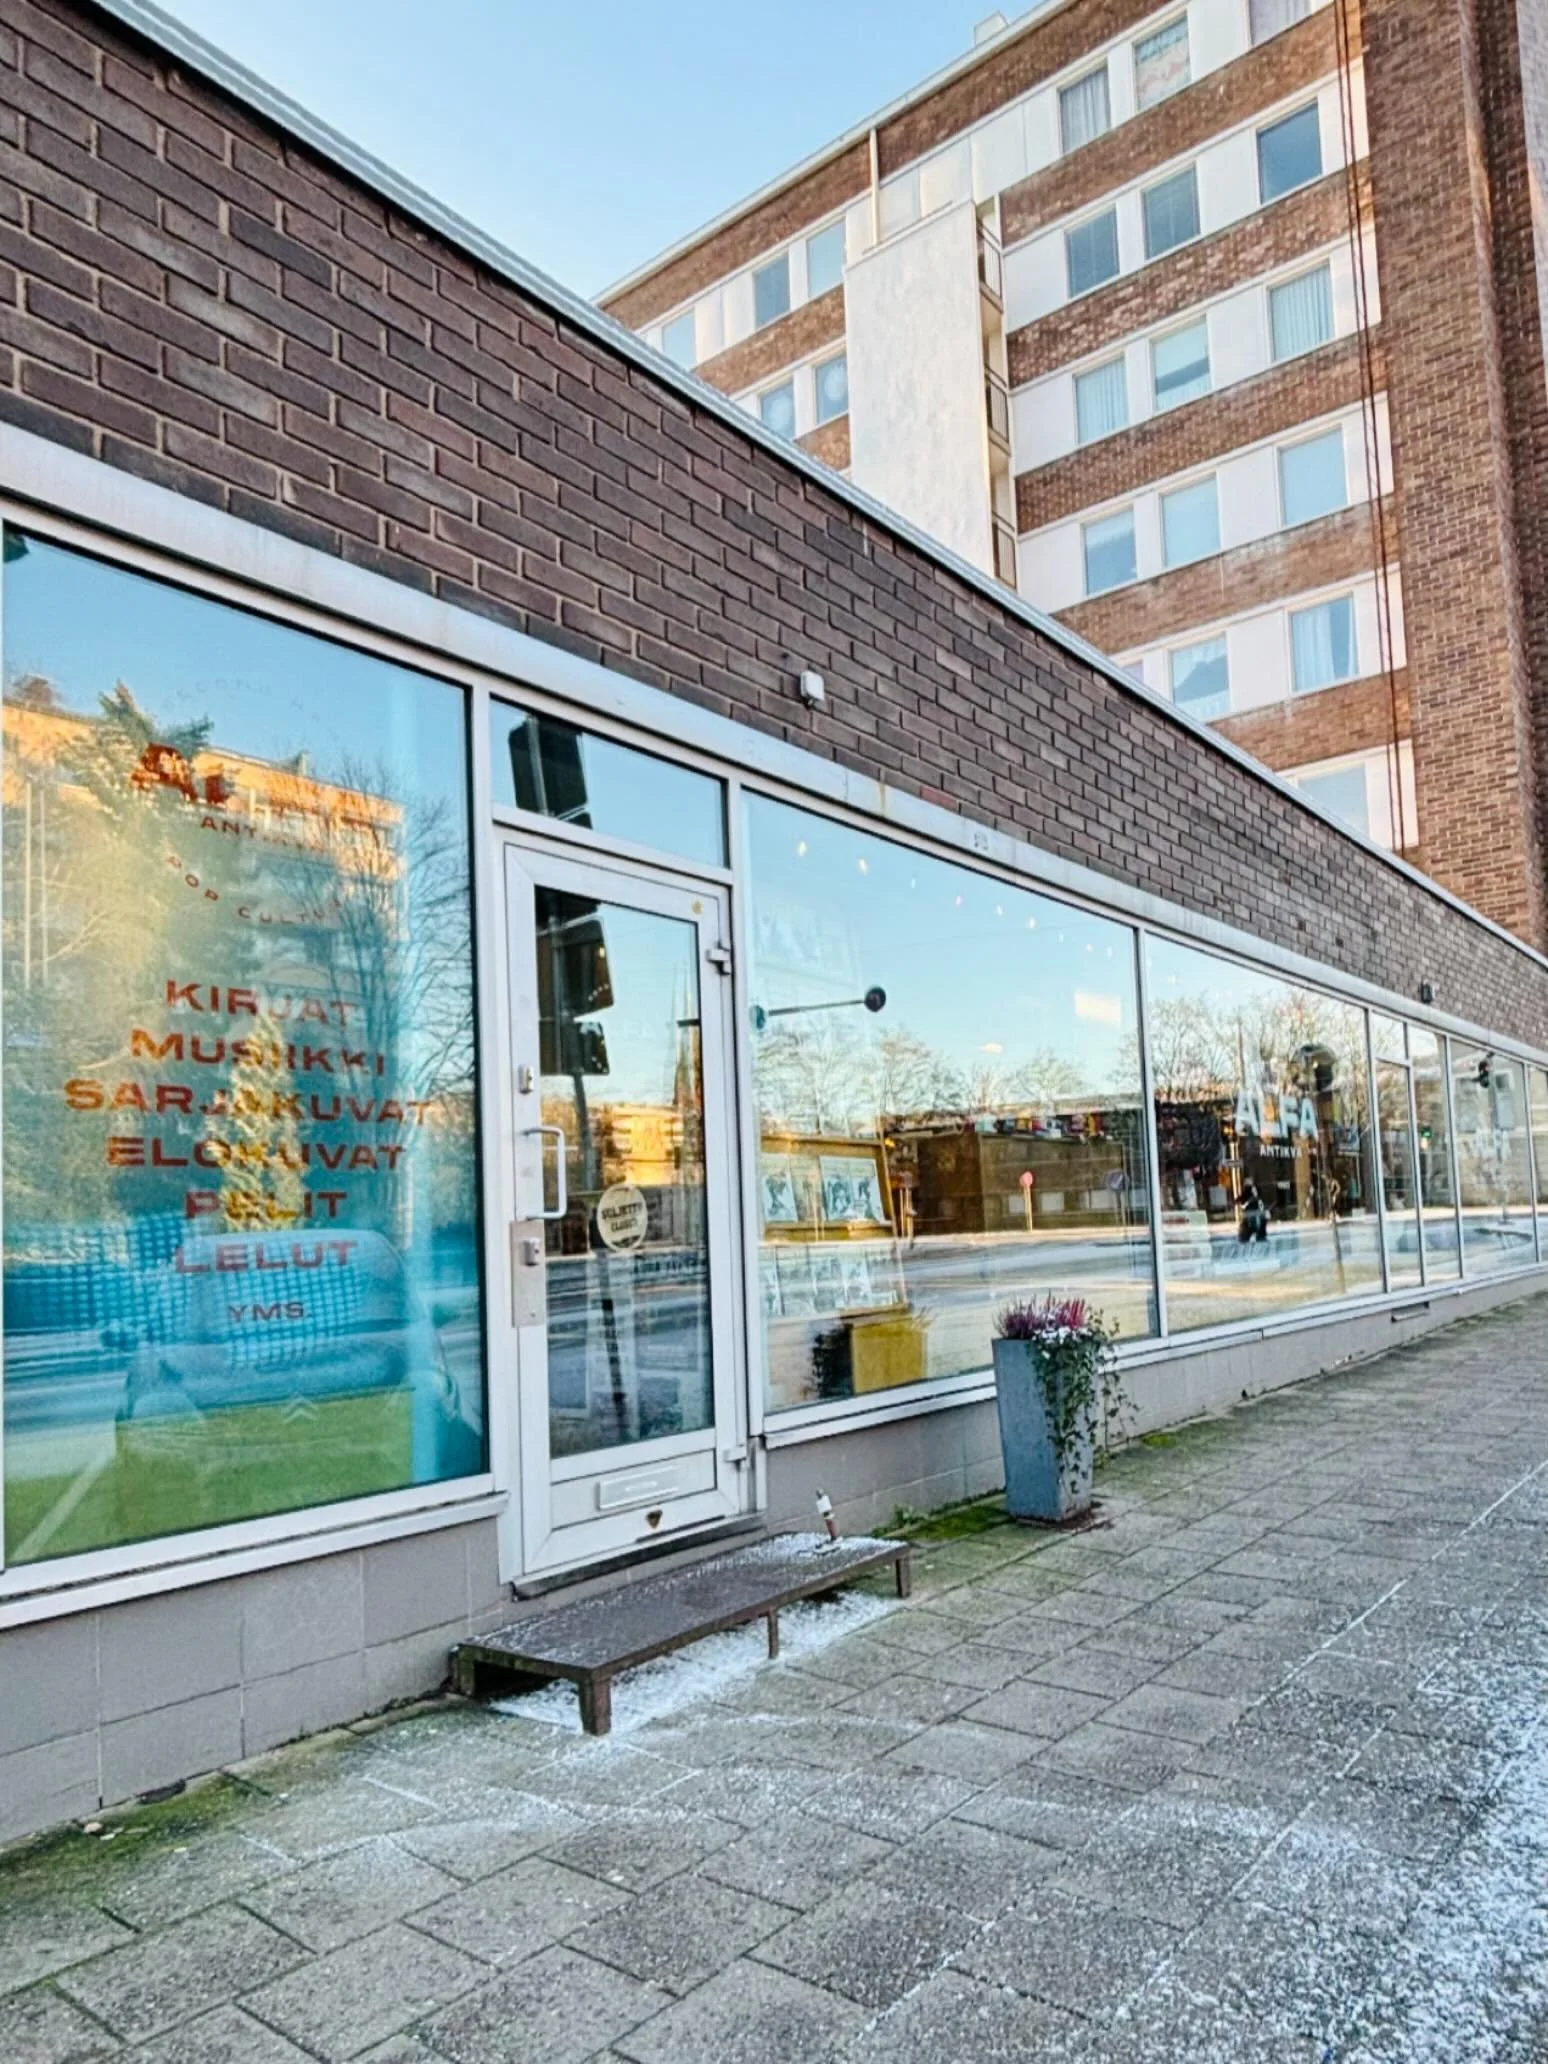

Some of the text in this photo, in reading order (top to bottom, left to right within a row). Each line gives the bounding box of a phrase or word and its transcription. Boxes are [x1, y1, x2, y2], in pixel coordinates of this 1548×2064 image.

[166, 980, 357, 1027] KIRJAT
[131, 1028, 385, 1077] MUSIIKKI
[64, 1078, 432, 1125] SARJAKUVAT
[105, 1137, 406, 1169] ELOKUVAT
[185, 1191, 347, 1219] PELIT
[175, 1240, 357, 1273] LELUT
